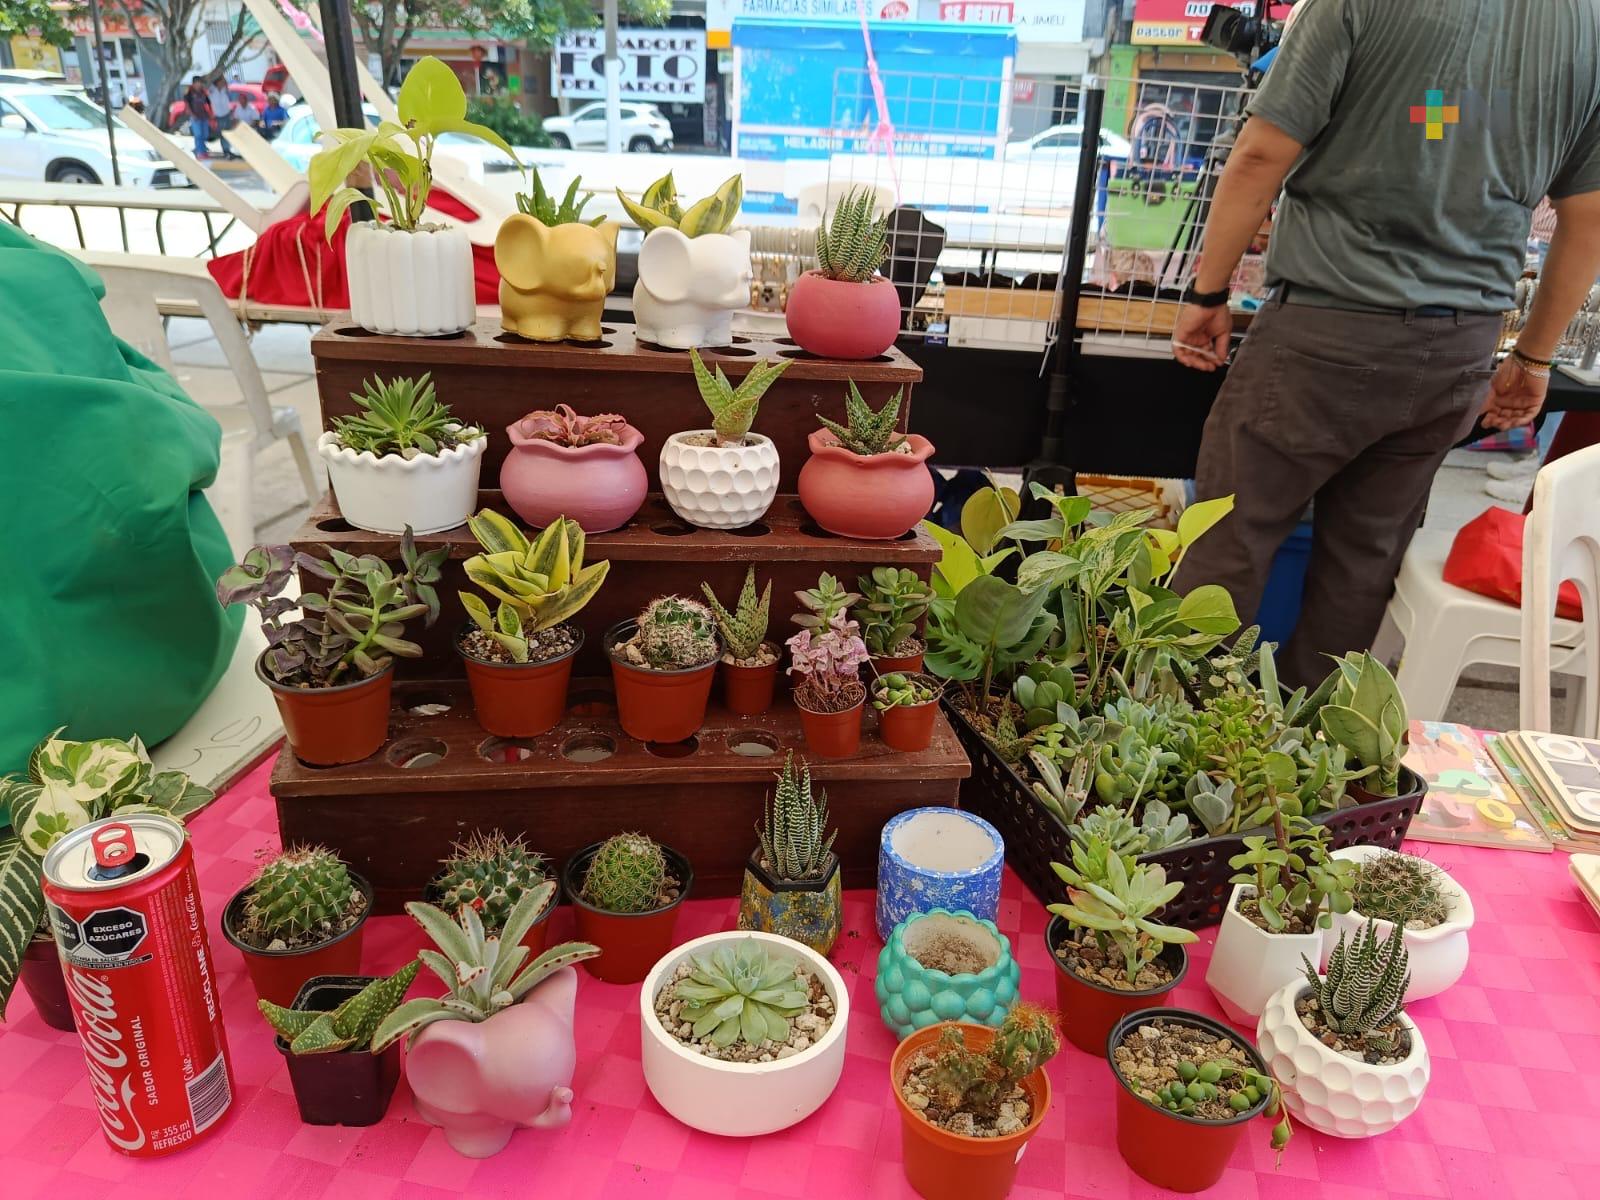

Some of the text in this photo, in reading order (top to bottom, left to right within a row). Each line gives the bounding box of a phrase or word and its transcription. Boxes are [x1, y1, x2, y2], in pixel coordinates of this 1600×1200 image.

[743, 0, 807, 15] FARMACIAS
[617, 38, 697, 51] ARQUE
[560, 52, 698, 80] FOTO
[561, 79, 697, 94] DEL ARQUE
[852, 138, 948, 155] ARANALES
[88, 927, 143, 942] AZÚCARES
[92, 921, 134, 934] EXCESO
[129, 1015, 159, 1106] SABOR ORIGINAL
[163, 1124, 178, 1138] 355
[179, 1119, 191, 1132] ml
[152, 1129, 193, 1151] REFRESCO
